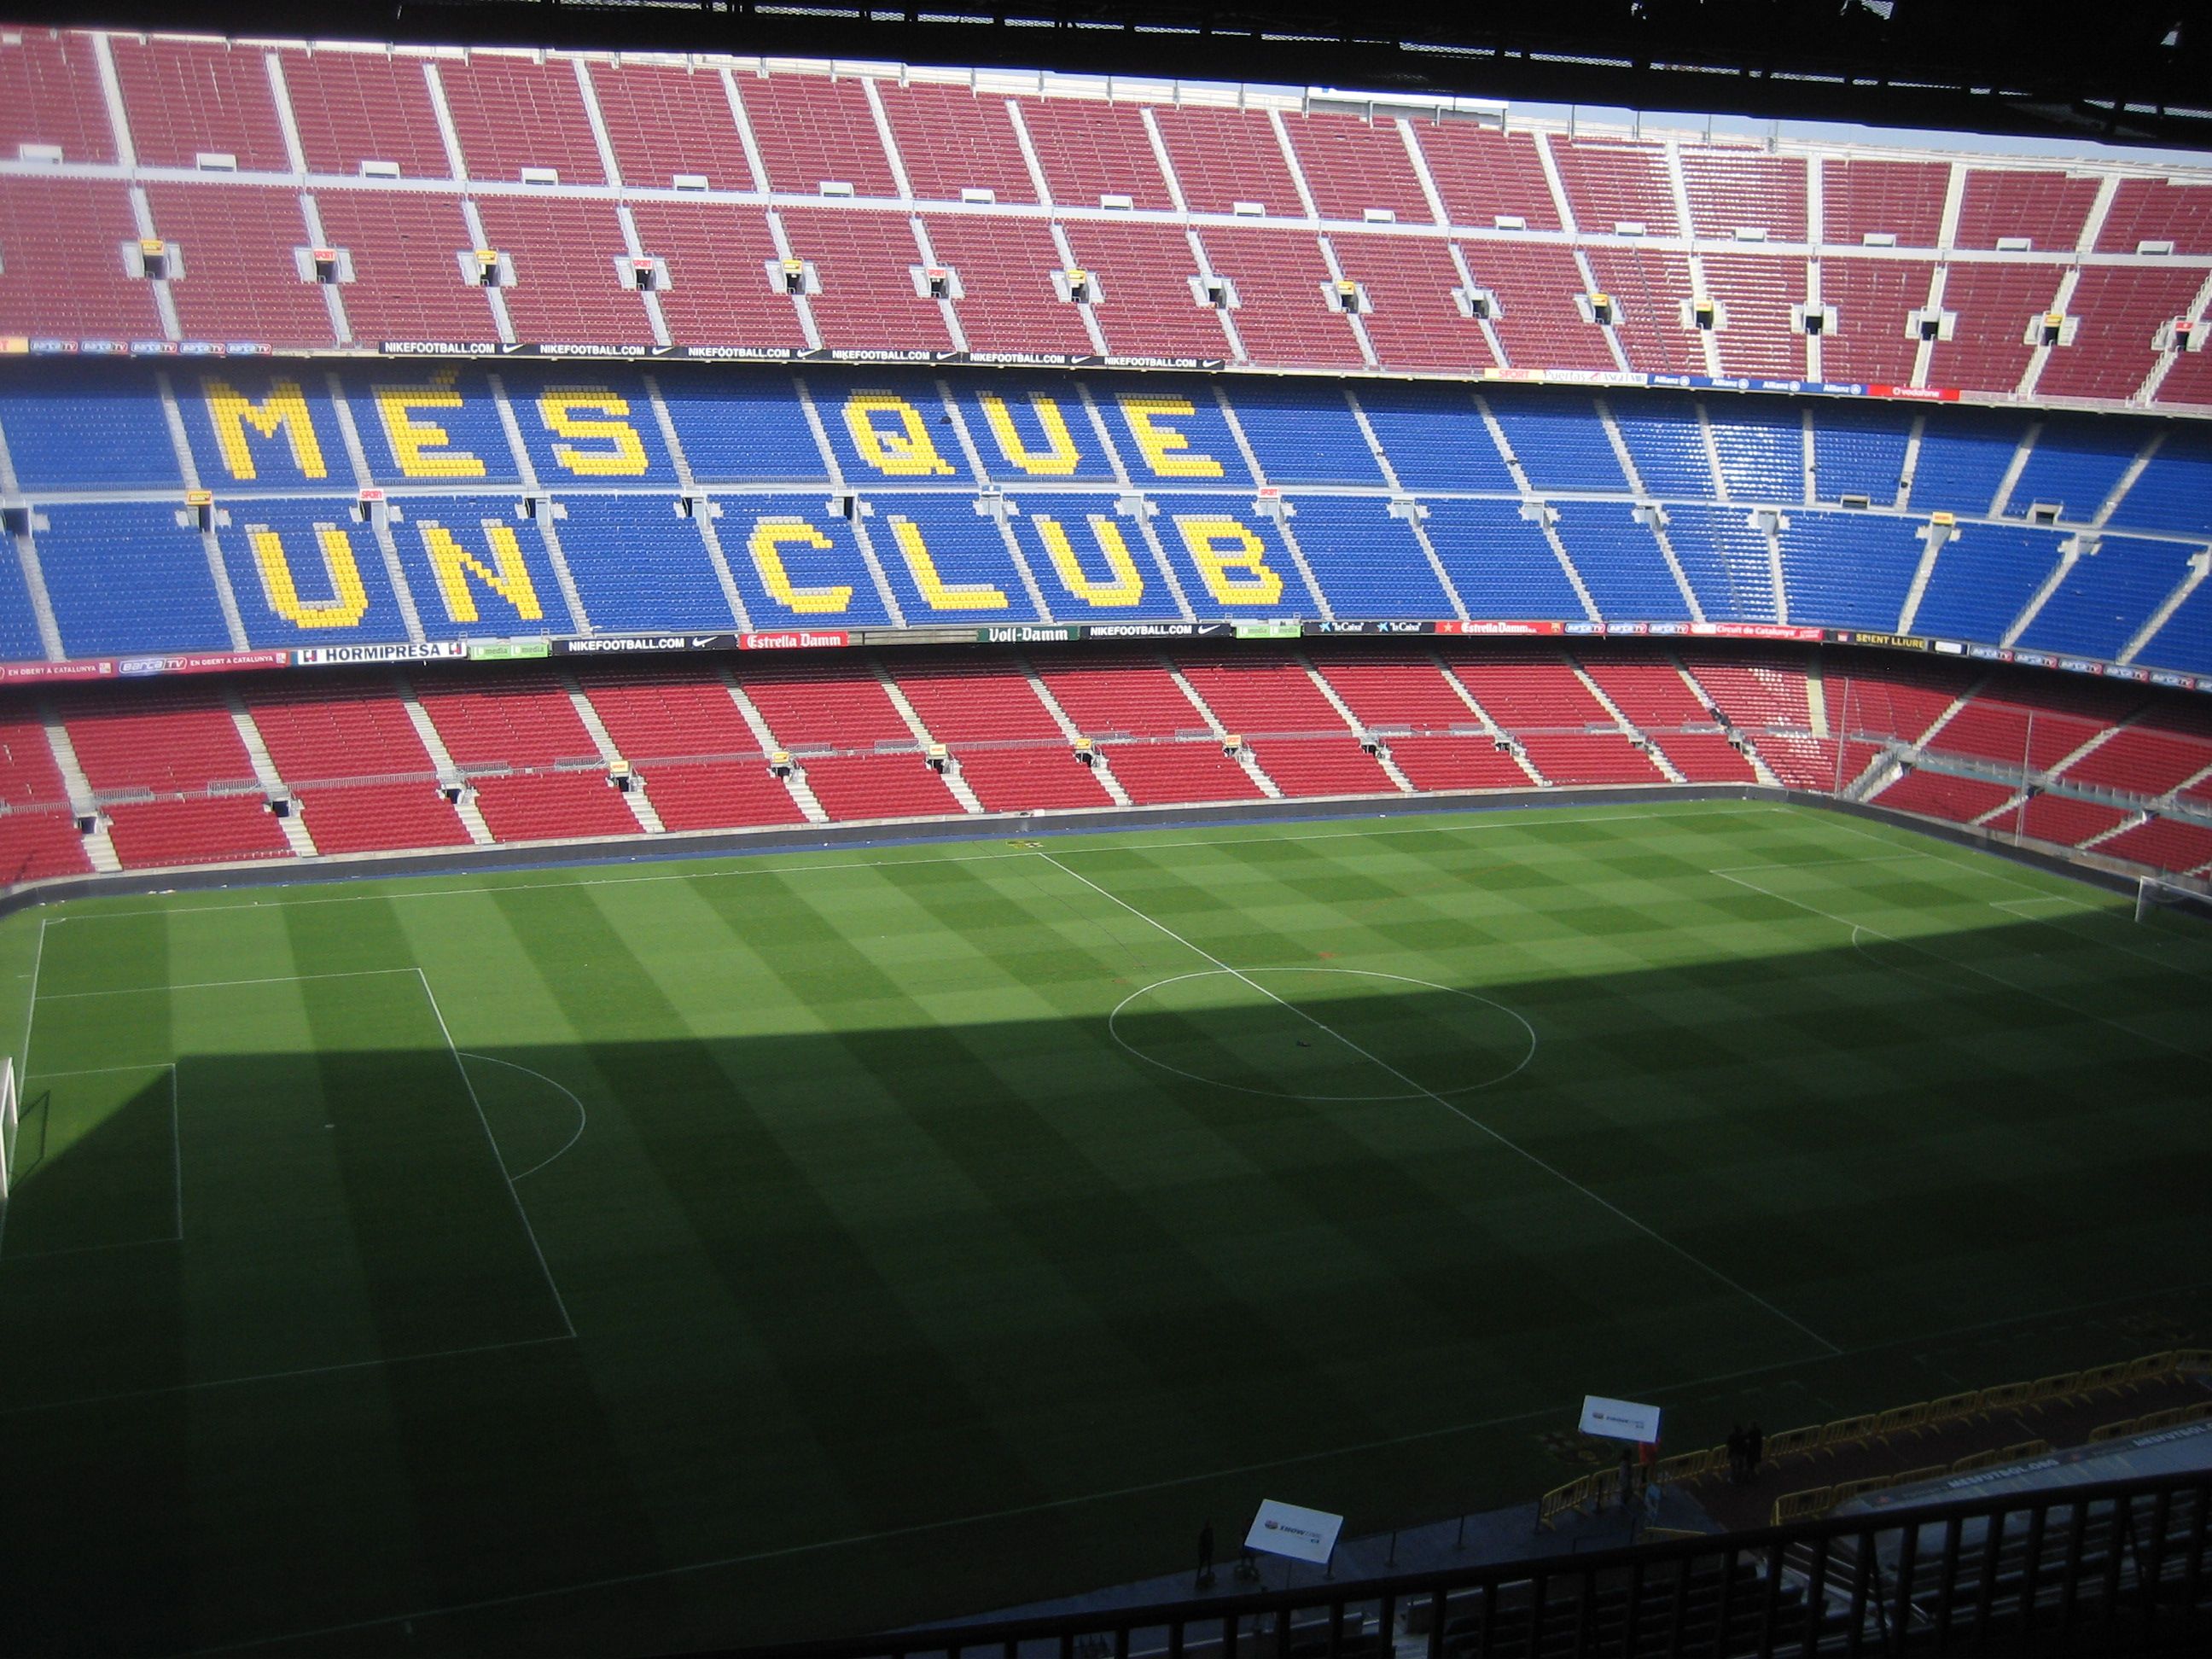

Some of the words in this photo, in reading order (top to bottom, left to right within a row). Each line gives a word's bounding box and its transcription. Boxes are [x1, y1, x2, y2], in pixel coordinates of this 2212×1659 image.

[385, 343, 495, 354] NIKEFOOTBALL.COM
[540, 345, 645, 356] NIKEFOOTBALL.COM
[689, 347, 790, 358] NIKEFOOTBALL.COM
[832, 349, 929, 361] NIKEFOOTBALL.COM
[970, 353, 1065, 364] NIKEFOOTBALL.COM
[1104, 357, 1196, 368] NIKEFOOTBALL.COM
[1499, 370, 1529, 379] SPORT
[1544, 370, 1586, 381] Puertas
[1654, 375, 1679, 384] Allianz
[1712, 377, 1738, 387] Allianz
[1762, 381, 1789, 389] Allianz
[1823, 385, 1850, 393] Allianz
[1901, 388, 1940, 398] vodafone
[840, 389, 1224, 476] QUE
[361, 490, 382, 499] SPORT
[245, 521, 544, 629] UN
[747, 515, 1284, 614] CLUB
[988, 626, 1068, 642] Voll-Damm
[1091, 626, 1192, 636] NIKEFOOTBALL.COM
[1755, 627, 1796, 637] Catalunya
[569, 638, 685, 651] NIKEFOOTBALL.COM
[748, 634, 798, 649] Estrella
[800, 632, 841, 646] Damm
[1891, 637, 1925, 649] LLIURE
[326, 644, 440, 662] HORMIPRESA
[167, 660, 184, 669] TV
[233, 655, 274, 664] CATALUNYA
[54, 665, 96, 674] CATALUNYA
